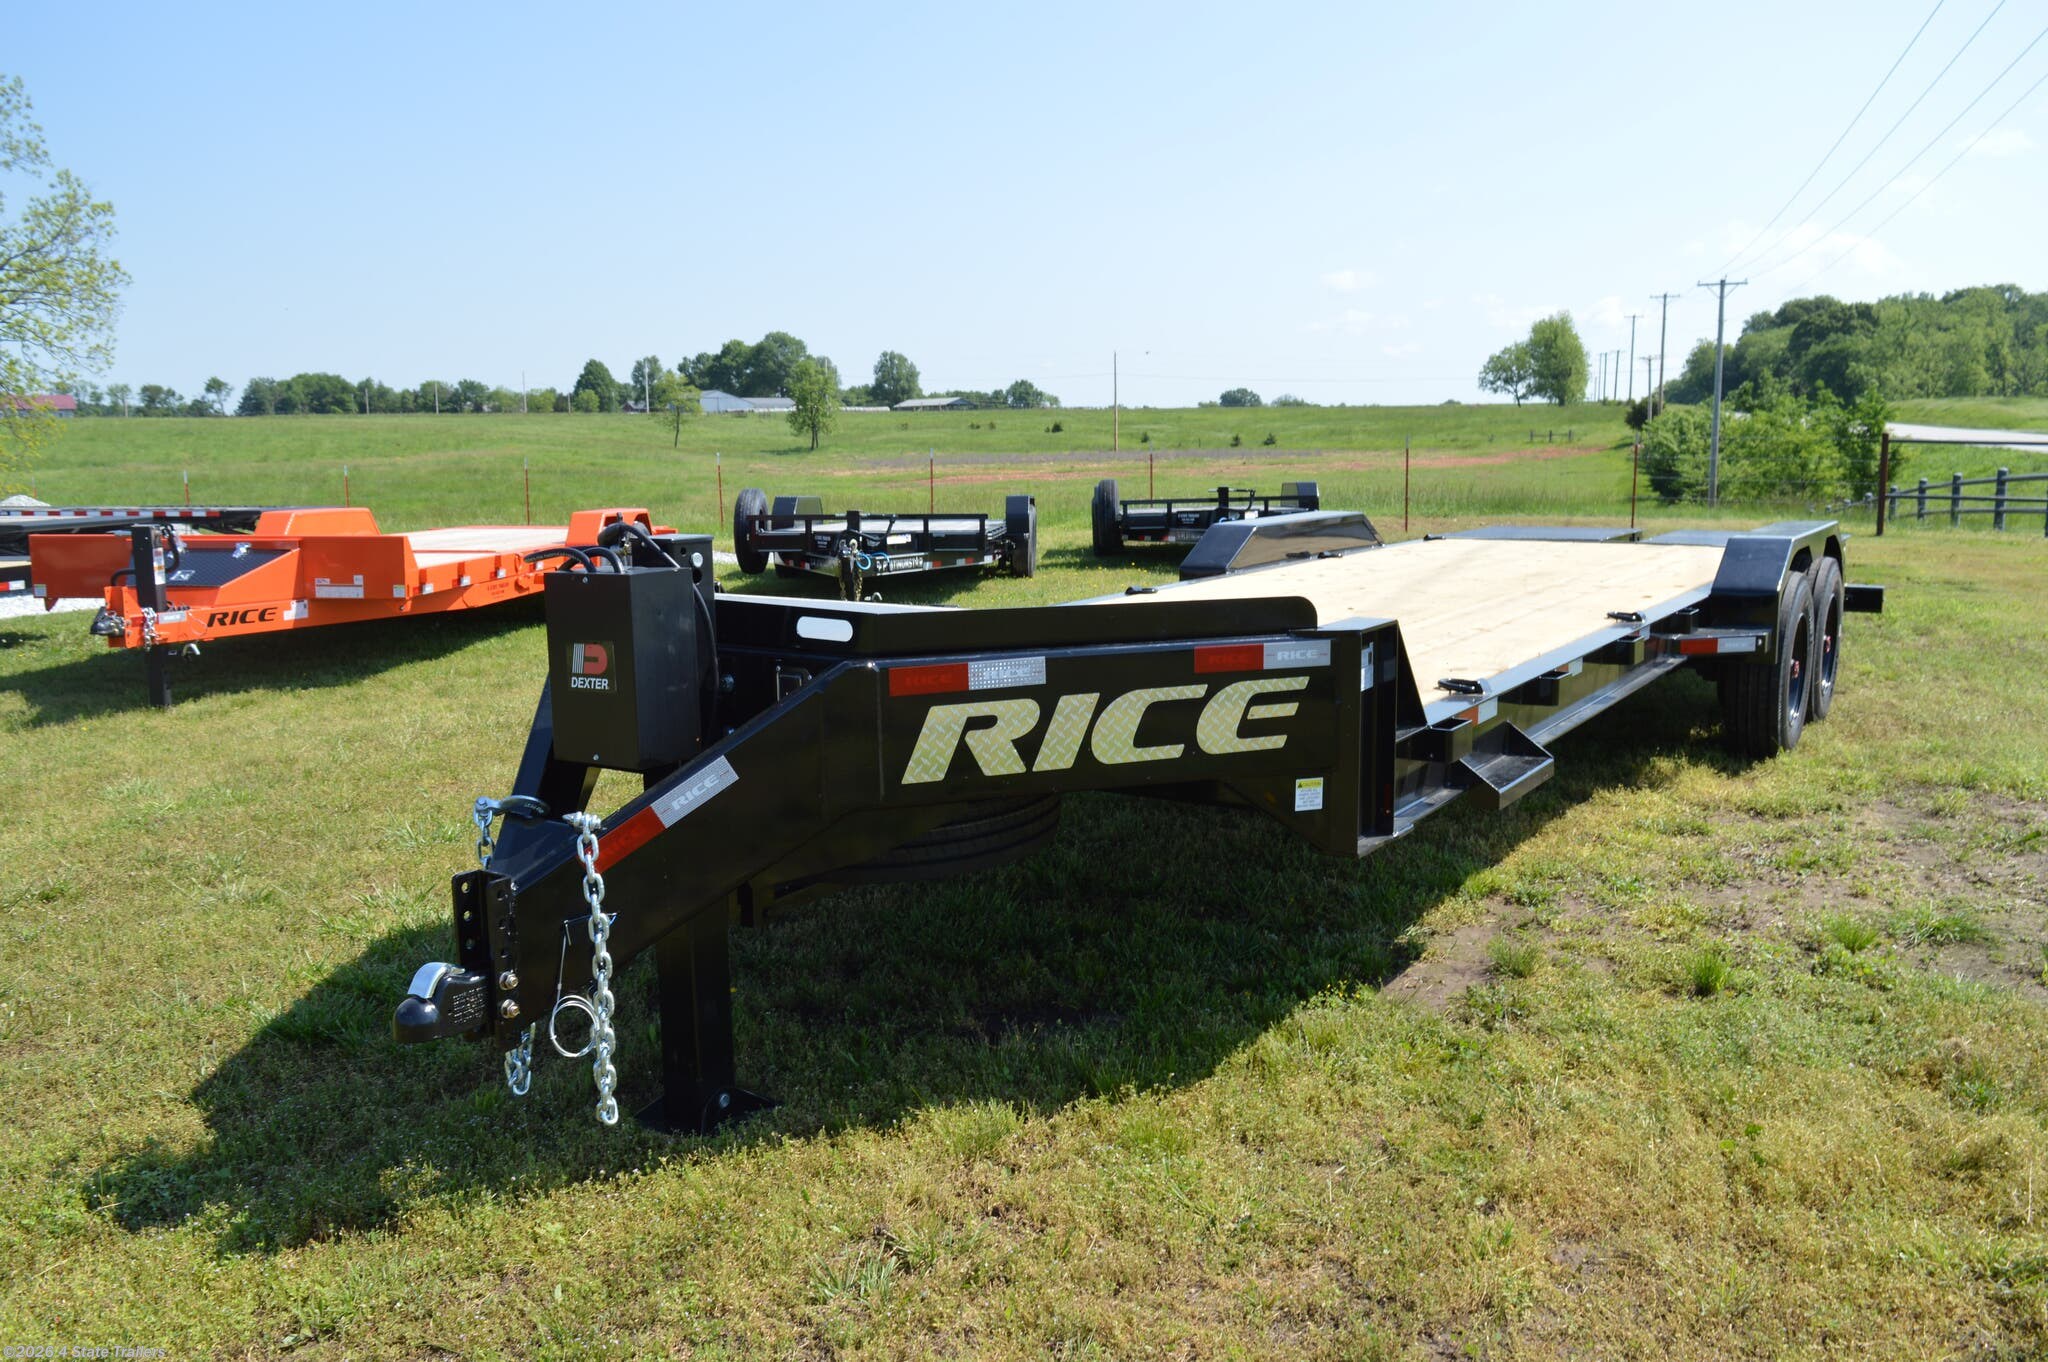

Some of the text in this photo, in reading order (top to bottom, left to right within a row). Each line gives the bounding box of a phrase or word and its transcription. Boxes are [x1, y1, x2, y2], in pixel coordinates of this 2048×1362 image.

[207, 607, 278, 628] RICE
[1277, 648, 1319, 661] RICE
[571, 676, 609, 690] DEXTER
[901, 676, 1310, 785] RICE
[671, 774, 720, 811] RICE
